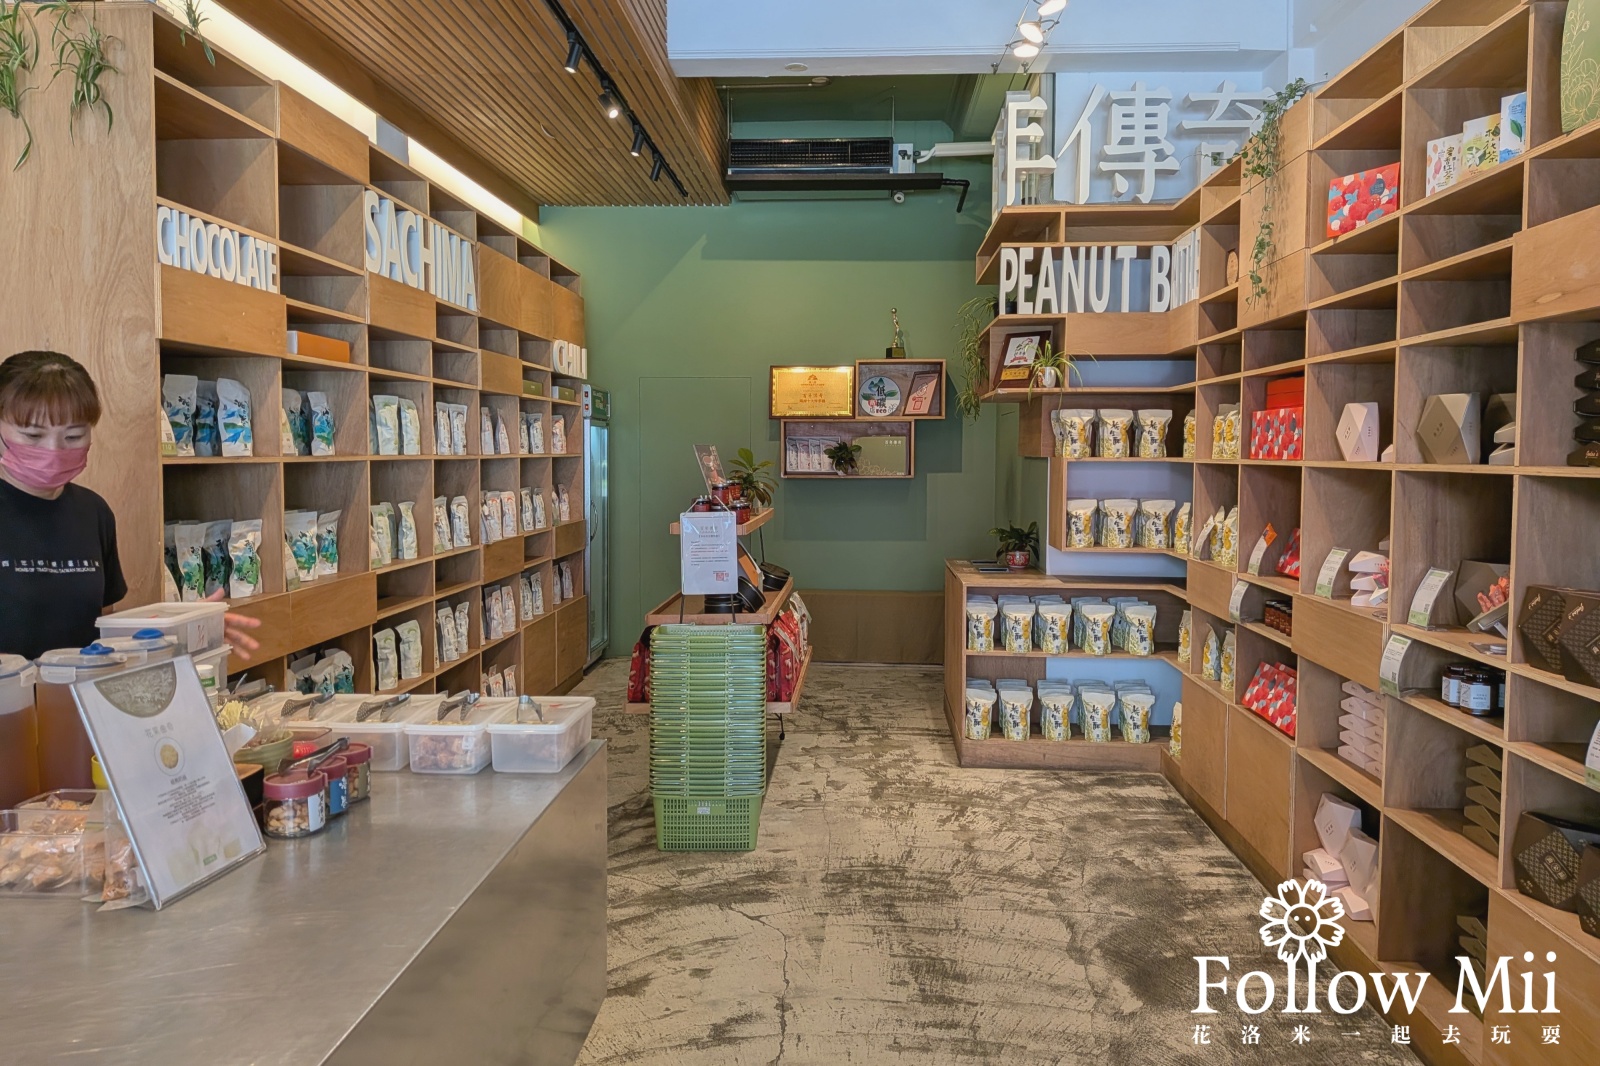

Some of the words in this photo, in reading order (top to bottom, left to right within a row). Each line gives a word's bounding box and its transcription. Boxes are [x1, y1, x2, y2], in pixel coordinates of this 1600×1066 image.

[157, 206, 279, 295] CHOCOLATE
[365, 190, 478, 312] SACHIMA
[1000, 246, 1138, 315] PEANUT
